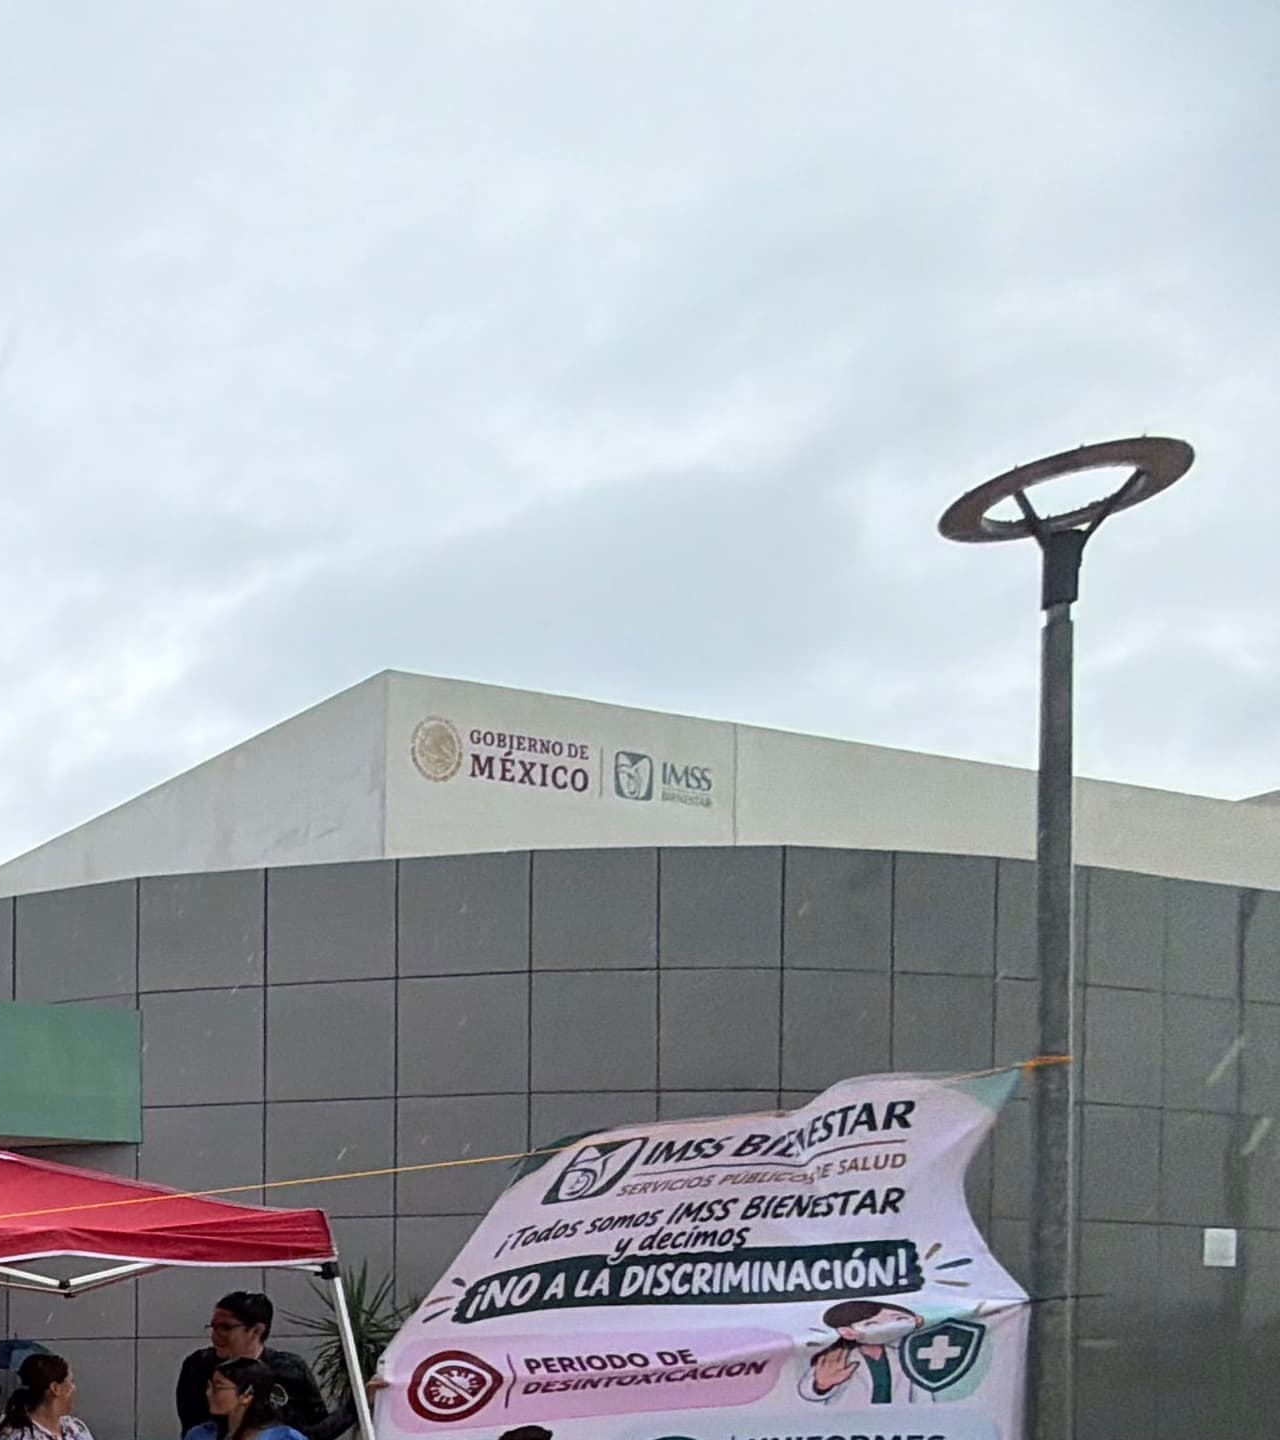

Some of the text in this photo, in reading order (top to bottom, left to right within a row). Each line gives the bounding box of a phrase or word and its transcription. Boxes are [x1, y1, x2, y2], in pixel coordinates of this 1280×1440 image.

[469, 729, 589, 760] GOBIERNO DE
[469, 750, 589, 793] MÉXICO
[662, 762, 713, 792] IMSS
[642, 1099, 916, 1166] IMSS BIENESTAR
[616, 1172, 713, 1198] SERVICIOS
[839, 1152, 908, 1174] SALUD
[494, 1186, 907, 1259] ¡Todos somos IMSS BIENESTAR
[609, 1224, 752, 1261] y decimos
[464, 1247, 910, 1321] ¡NO A LA DISCRIMINACIÓN!
[522, 1348, 698, 1376] PERIODO DE
